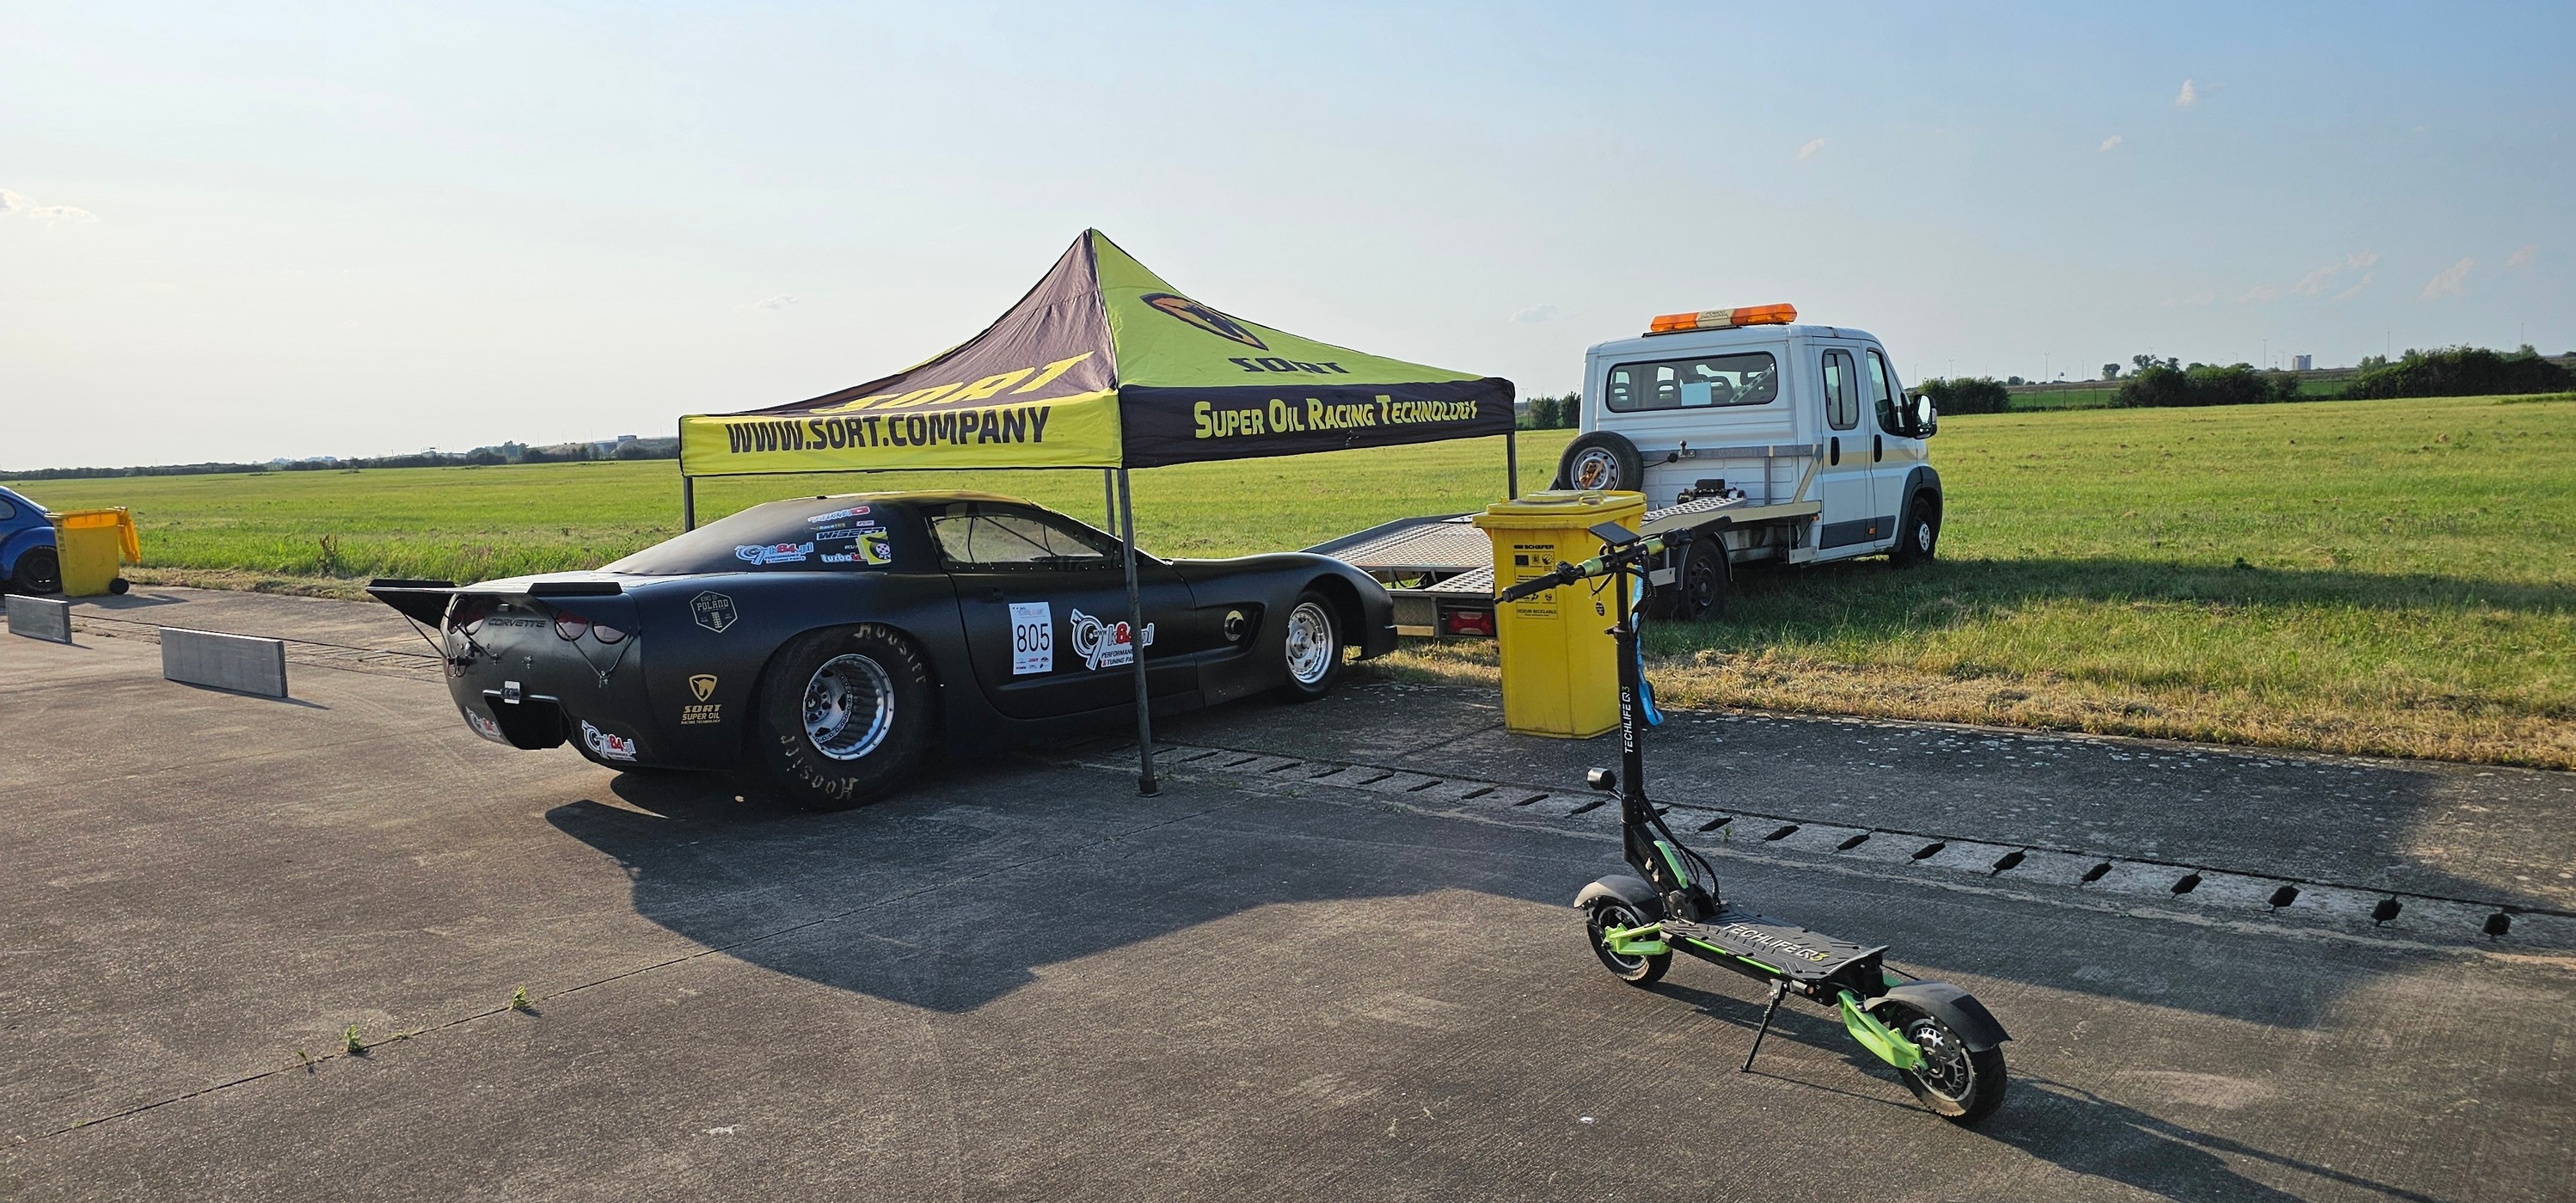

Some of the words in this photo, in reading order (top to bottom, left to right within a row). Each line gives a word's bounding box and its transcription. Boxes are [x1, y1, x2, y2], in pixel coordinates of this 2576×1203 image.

[1228, 357, 1351, 374] SORT
[726, 406, 1051, 454] WWW.SORT.COMPANY
[1193, 401, 1265, 439] SUPER
[1268, 399, 1304, 433] OIL
[1305, 398, 1377, 430] RACING
[1376, 395, 1478, 425] TECHNOLOGY
[696, 599, 729, 611] POLAND
[488, 618, 546, 628] CORVETTE
[1017, 623, 1050, 653] 805
[684, 704, 721, 714] SORT
[1622, 703, 1634, 753] TECHLIFE
[1723, 923, 1803, 954] TECHLIFE
